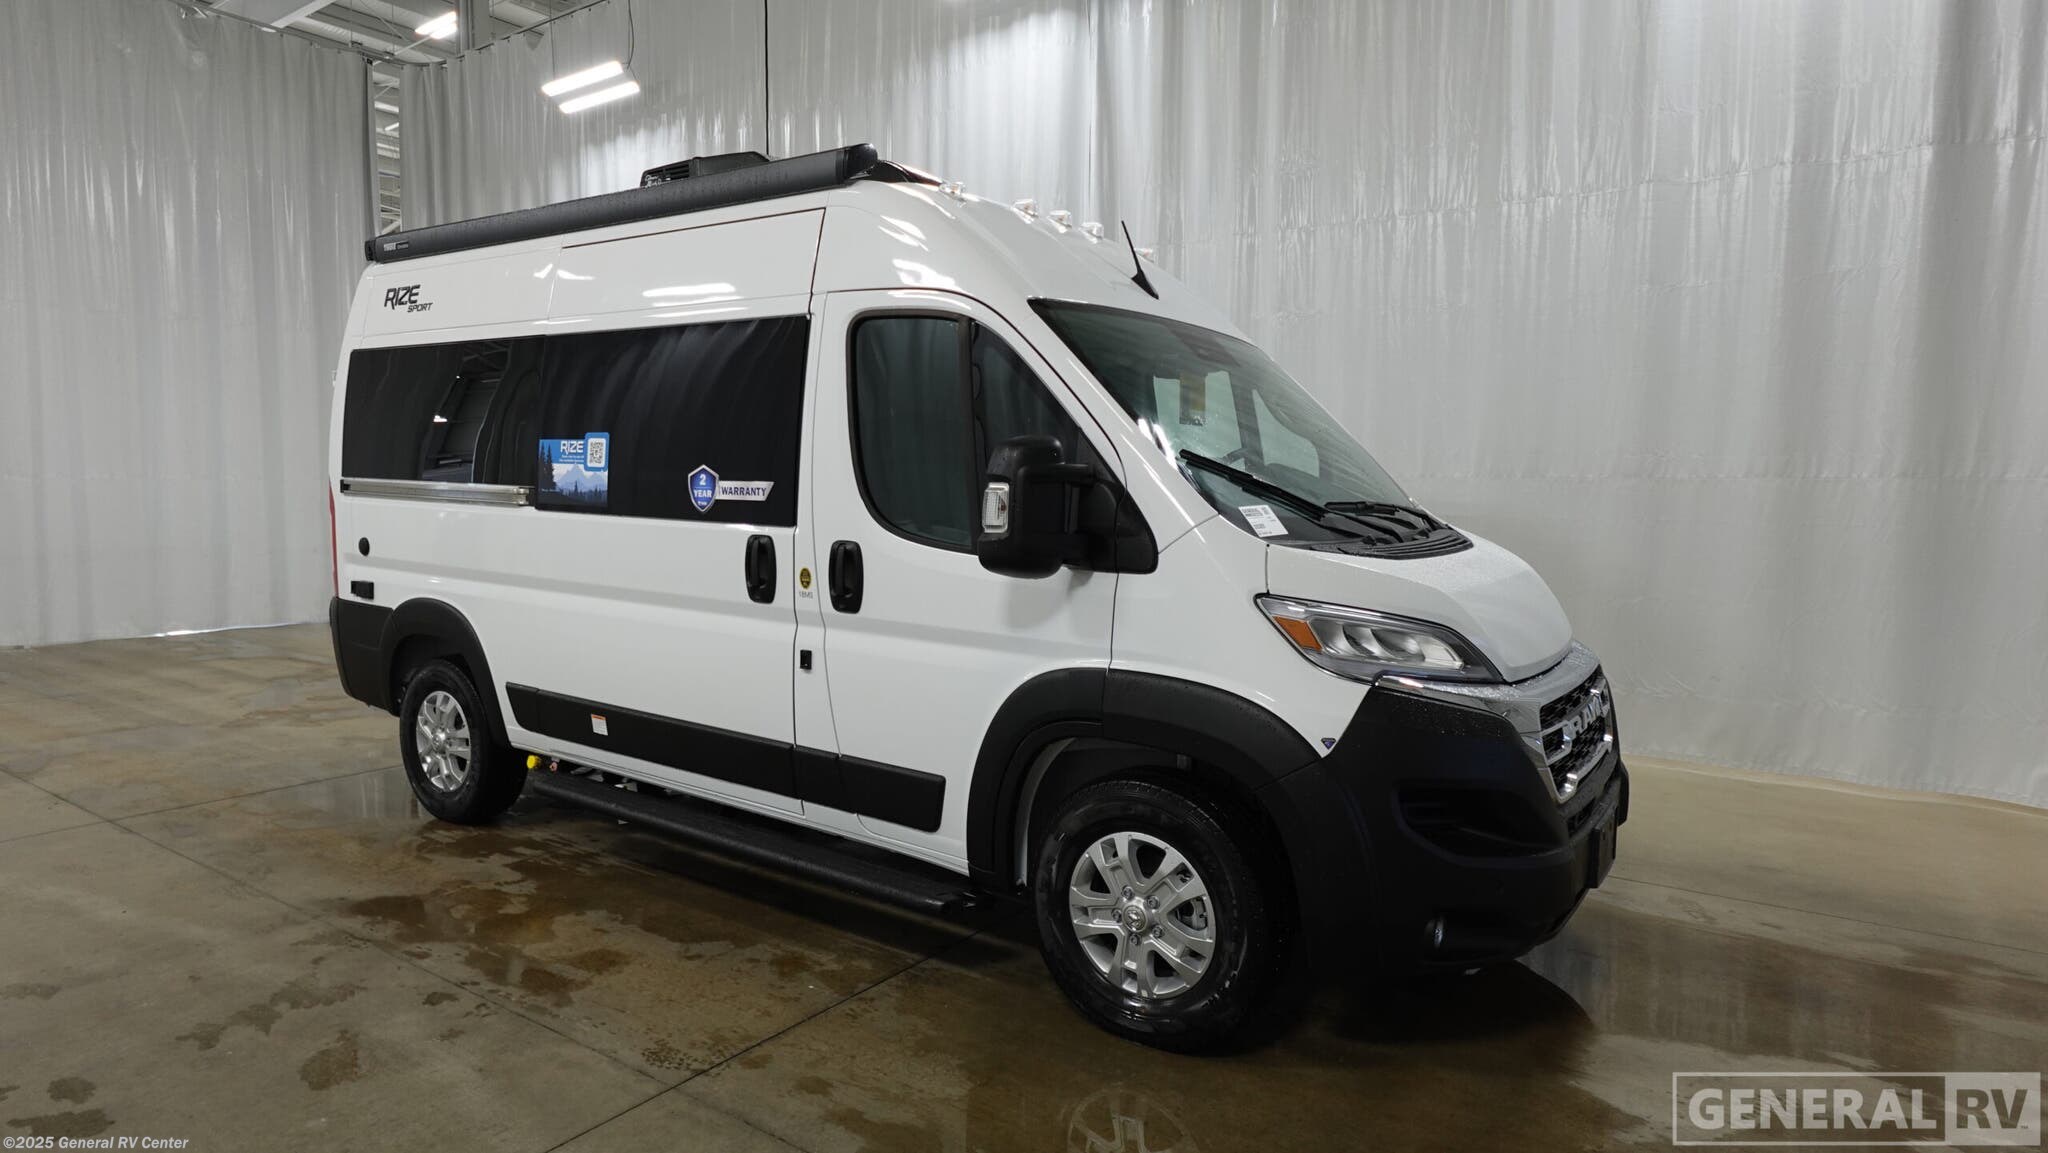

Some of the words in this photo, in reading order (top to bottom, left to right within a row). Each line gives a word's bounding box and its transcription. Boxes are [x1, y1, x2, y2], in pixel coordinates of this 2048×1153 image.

[384, 284, 421, 310] RIZE
[407, 302, 434, 313] SPORT
[560, 440, 584, 455] RIZE
[699, 473, 706, 486] 2
[693, 489, 712, 498] YEAR
[721, 486, 767, 497] WARRANTY
